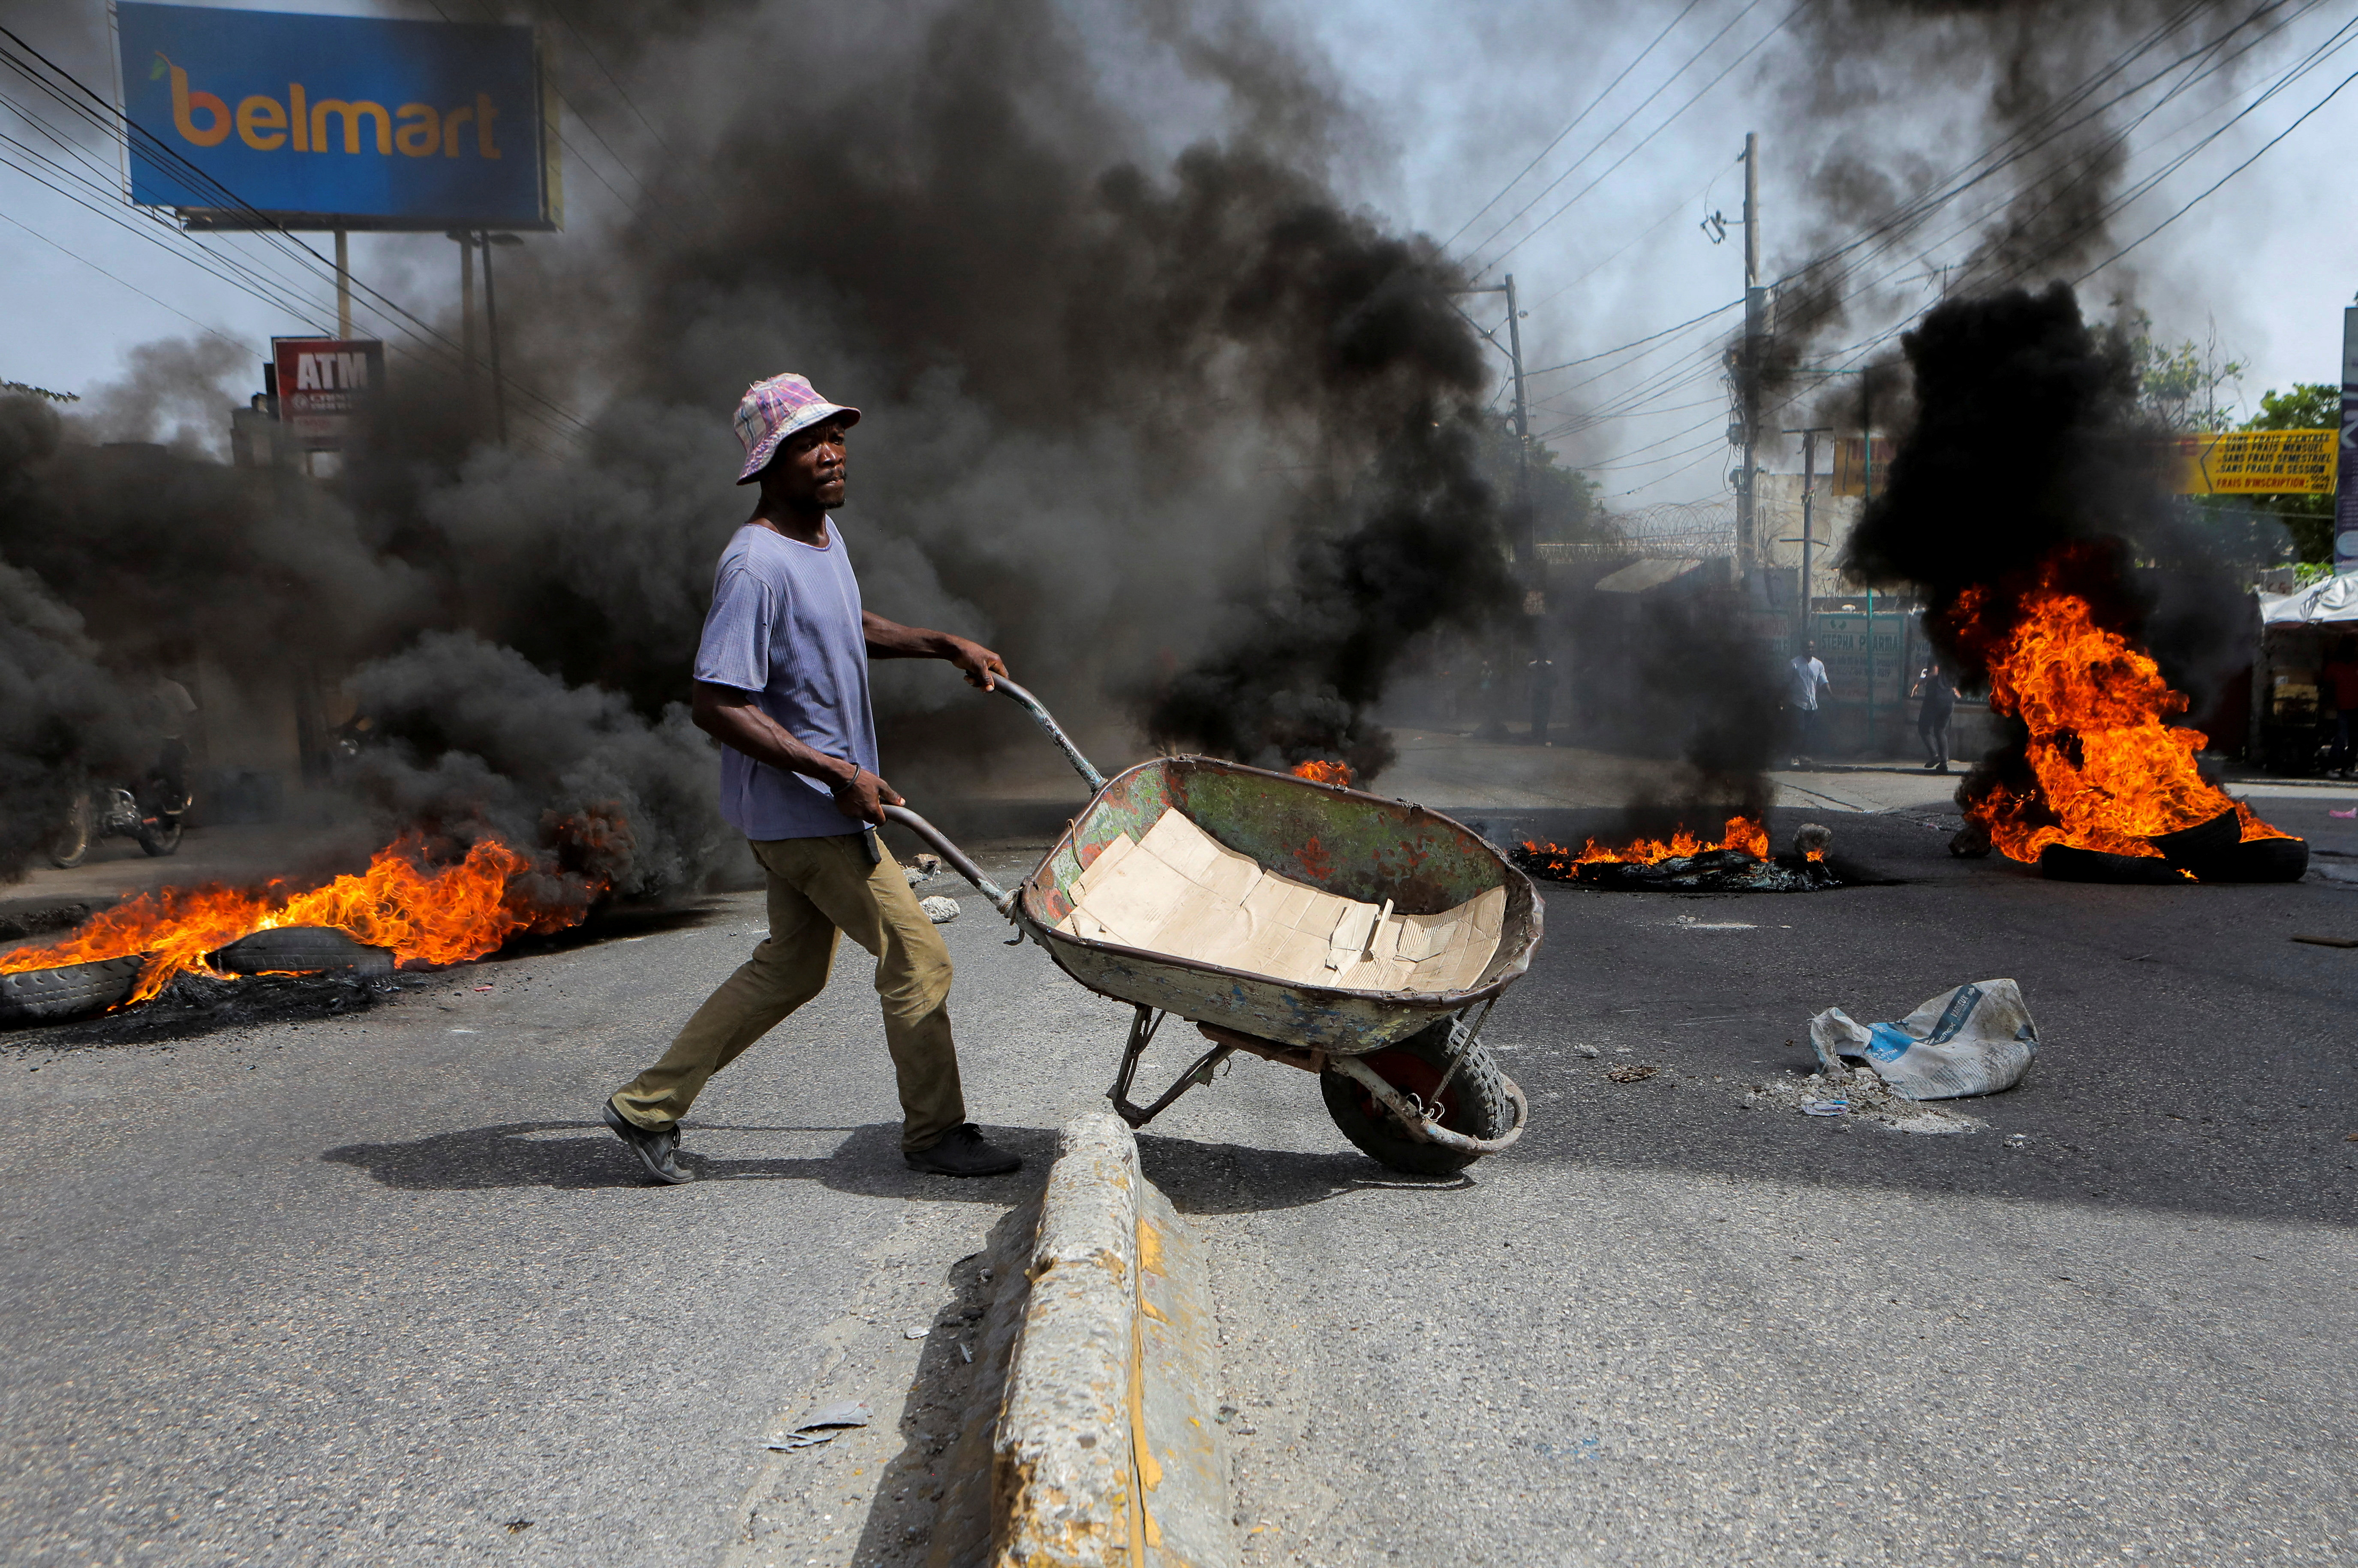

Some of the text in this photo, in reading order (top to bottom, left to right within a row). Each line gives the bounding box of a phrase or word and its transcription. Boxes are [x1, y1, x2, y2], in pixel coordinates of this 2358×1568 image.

[170, 63, 501, 160] belmart
[297, 352, 368, 390] ATM
[2225, 443, 2323, 452] SANS FRAIS MENSUEL
[2223, 454, 2244, 462] SANS
[2247, 453, 2274, 462] FRAIS
[2220, 463, 2325, 474] SANS FRAIS DE SESSION
[2217, 478, 2241, 488] FRAIS
[1822, 634, 1853, 651] STEPHA
[1859, 635, 1898, 652] PARMA
[1950, 994, 1969, 1018] VARREUX
